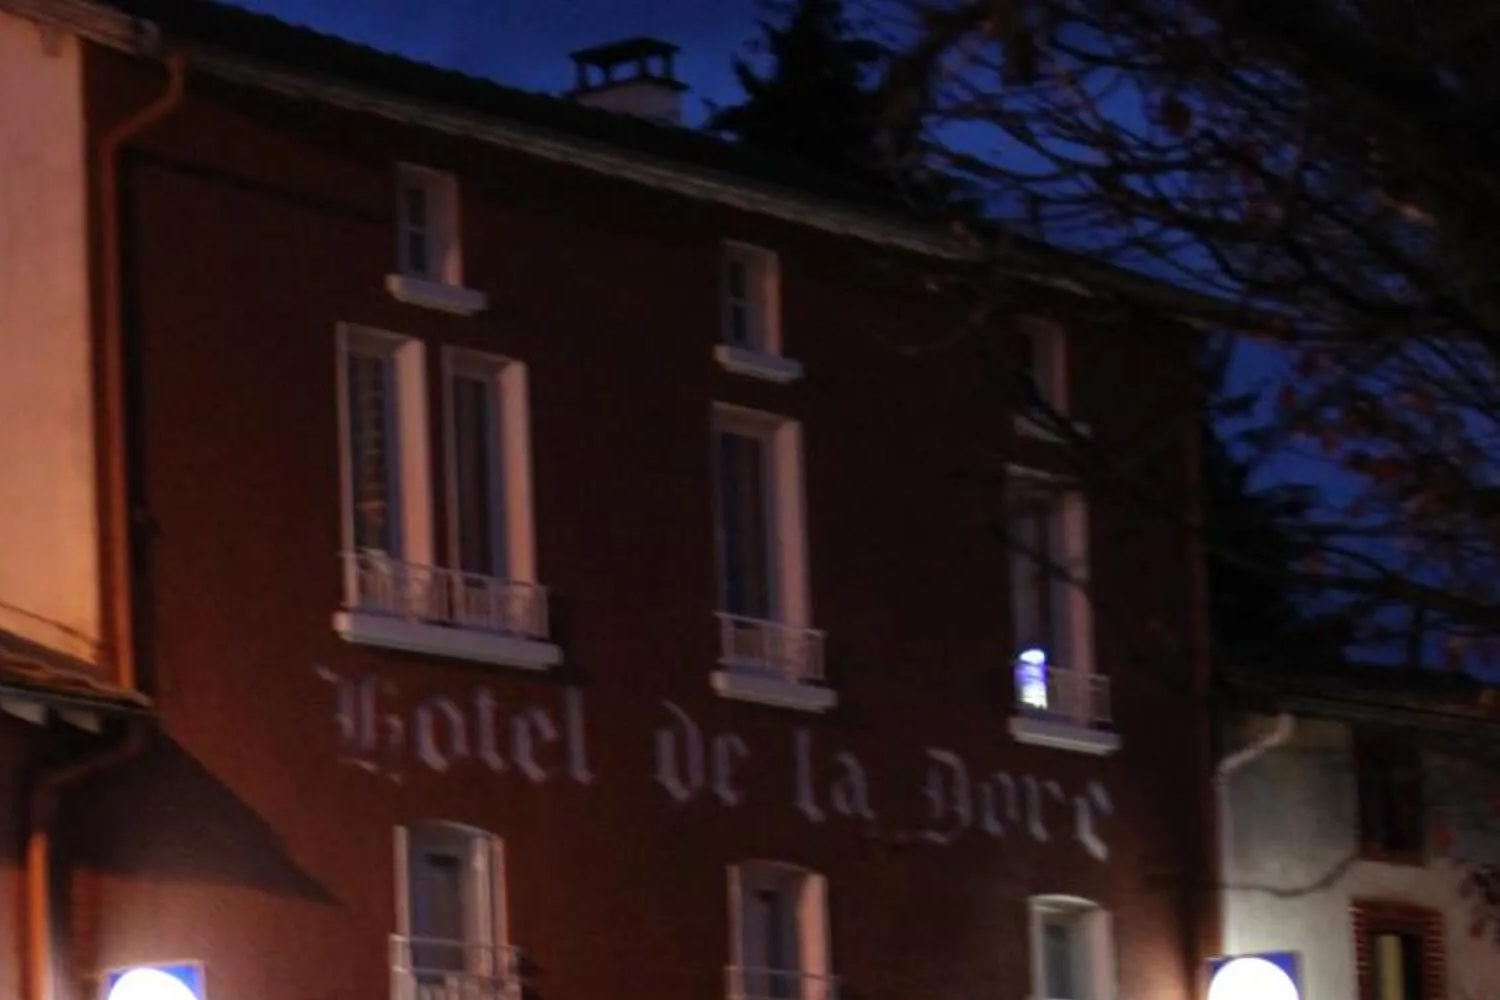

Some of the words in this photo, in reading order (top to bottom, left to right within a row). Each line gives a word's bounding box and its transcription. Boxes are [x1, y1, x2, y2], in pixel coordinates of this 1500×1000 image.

[312, 662, 595, 786] Hotel
[650, 697, 751, 804] de
[790, 725, 877, 823] la
[918, 745, 1117, 862] Dore
